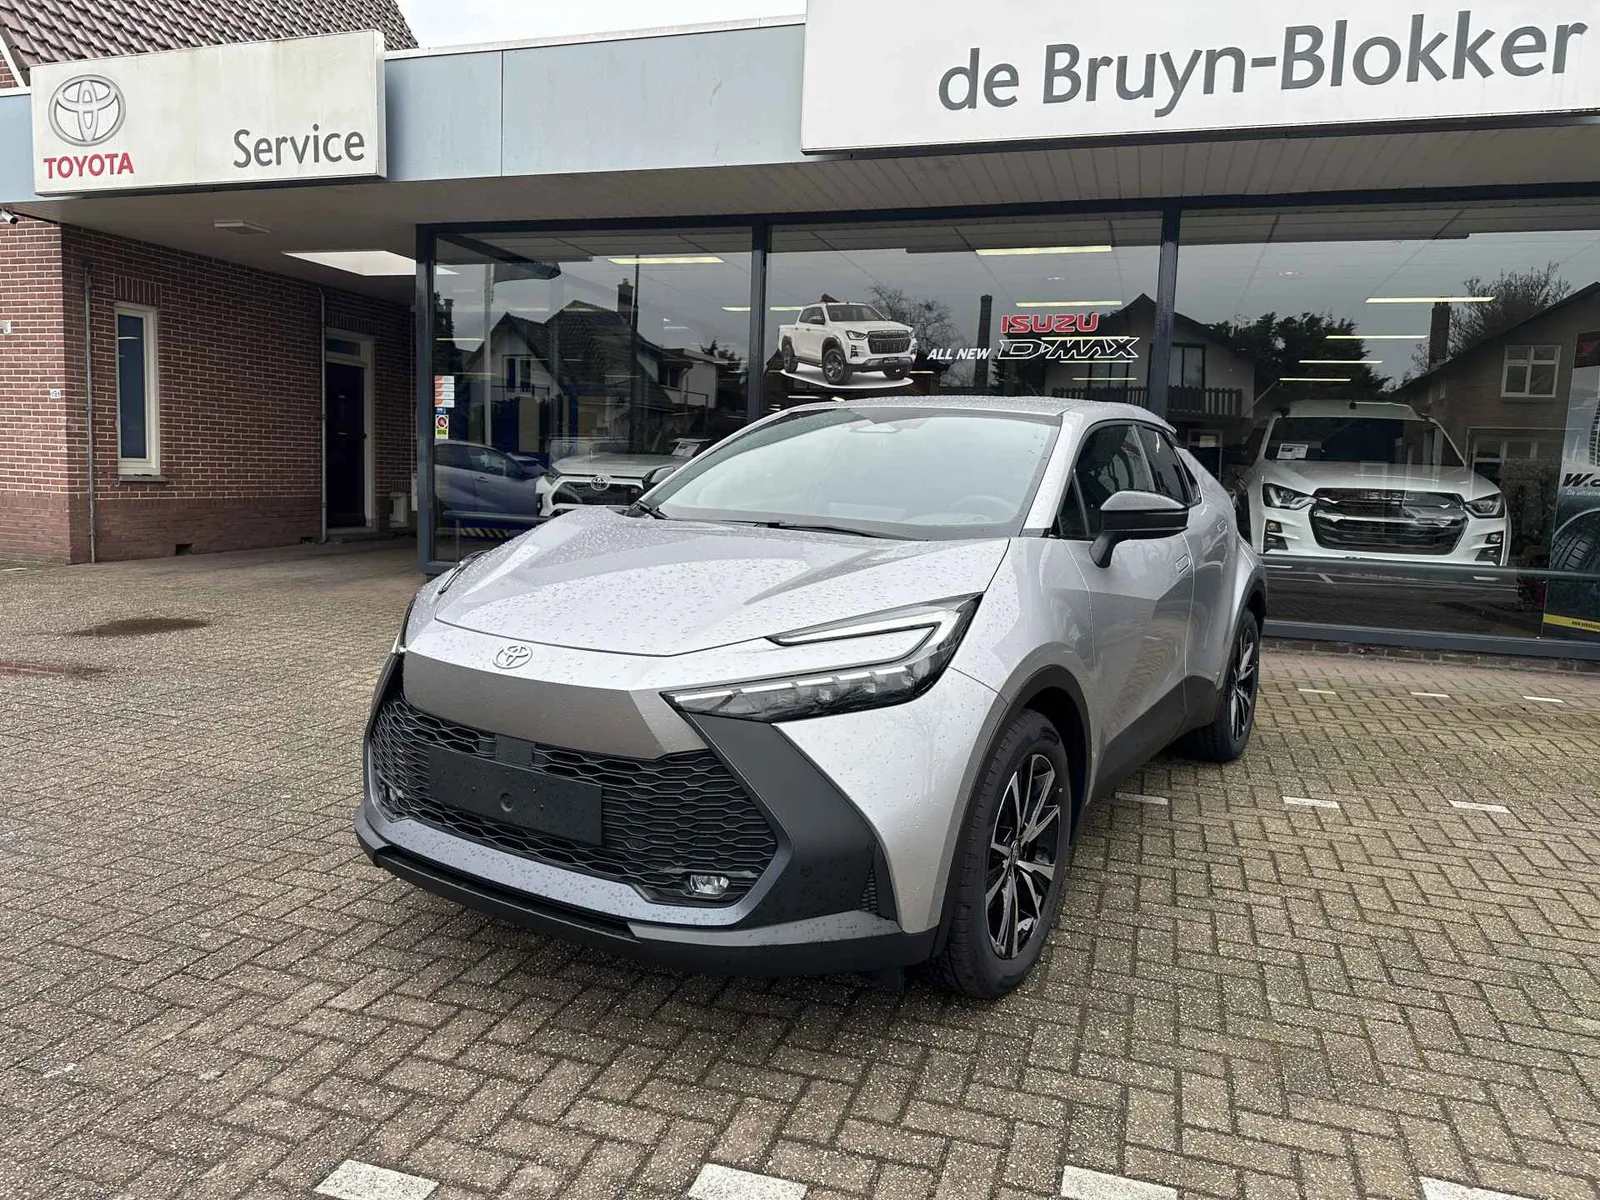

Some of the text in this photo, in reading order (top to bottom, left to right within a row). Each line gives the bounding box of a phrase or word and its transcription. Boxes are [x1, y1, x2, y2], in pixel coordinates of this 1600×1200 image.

[938, 11, 1589, 117] de Bruyn-Blokker
[233, 124, 365, 168] Service
[44, 153, 135, 179] TOYOTA
[1001, 313, 1100, 333] ISUZU
[927, 336, 1140, 360] ALL NEW D-MAX
